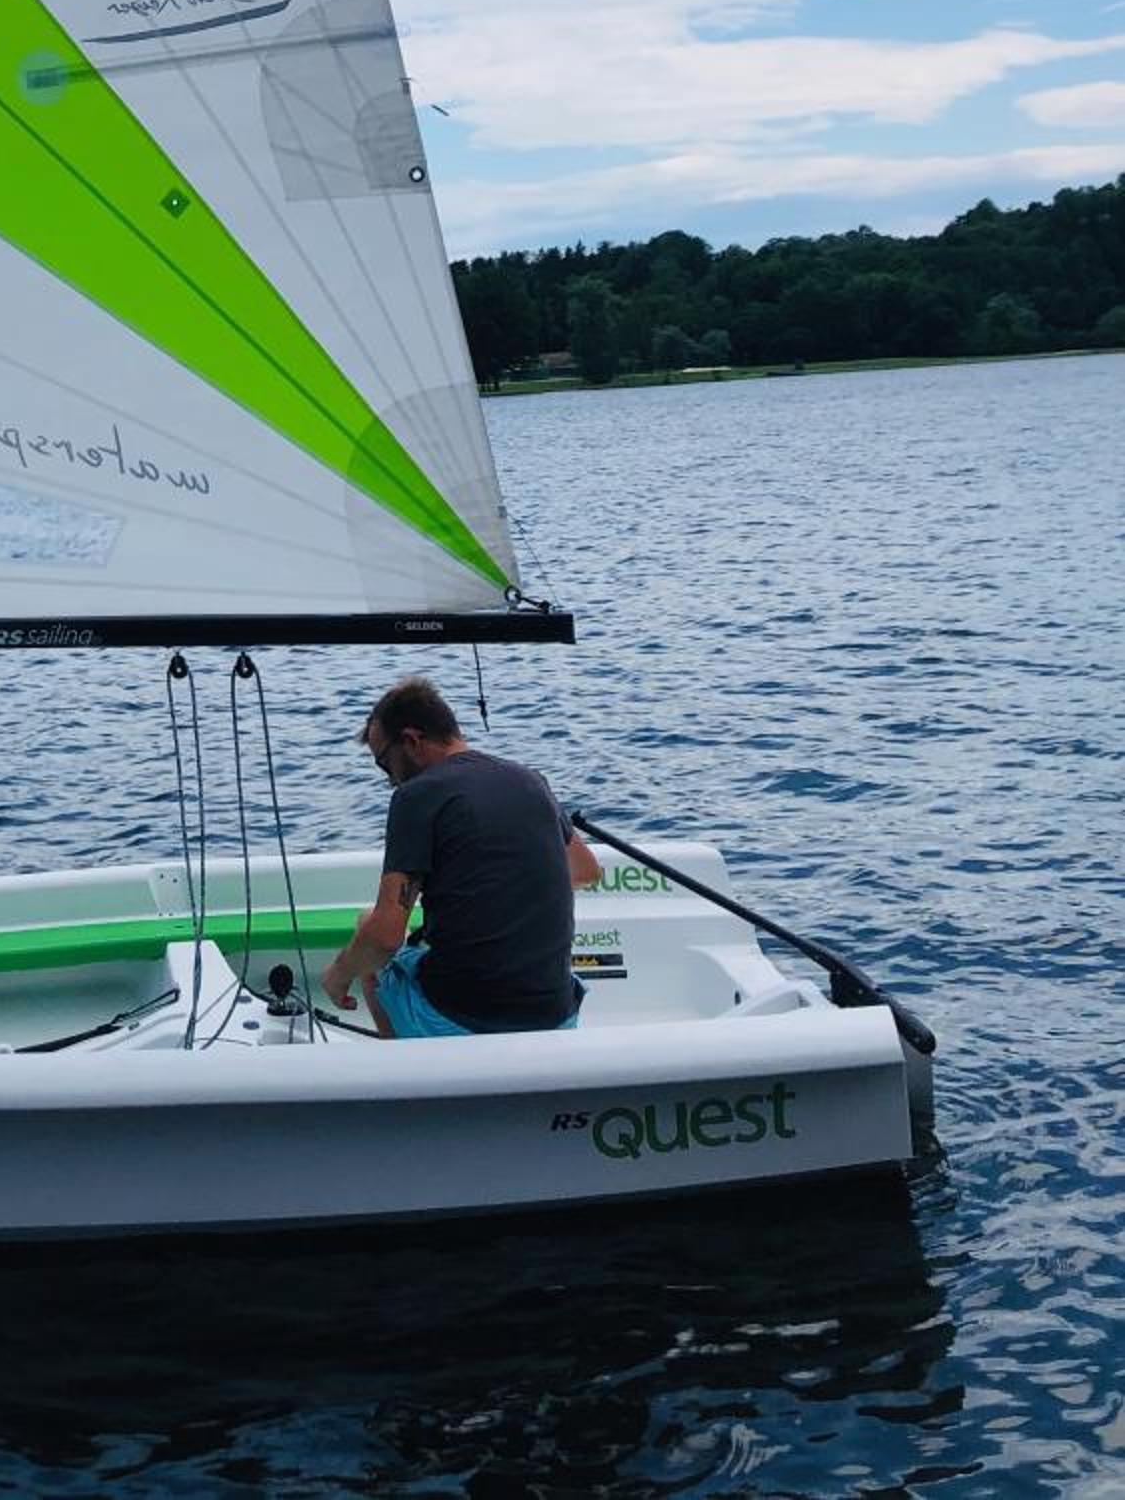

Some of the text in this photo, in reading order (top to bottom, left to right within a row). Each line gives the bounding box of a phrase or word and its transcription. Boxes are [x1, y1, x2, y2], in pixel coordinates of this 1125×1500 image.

[26, 622, 94, 645] sailing
[583, 865, 673, 893] uest
[550, 1081, 797, 1160] RS Quest
